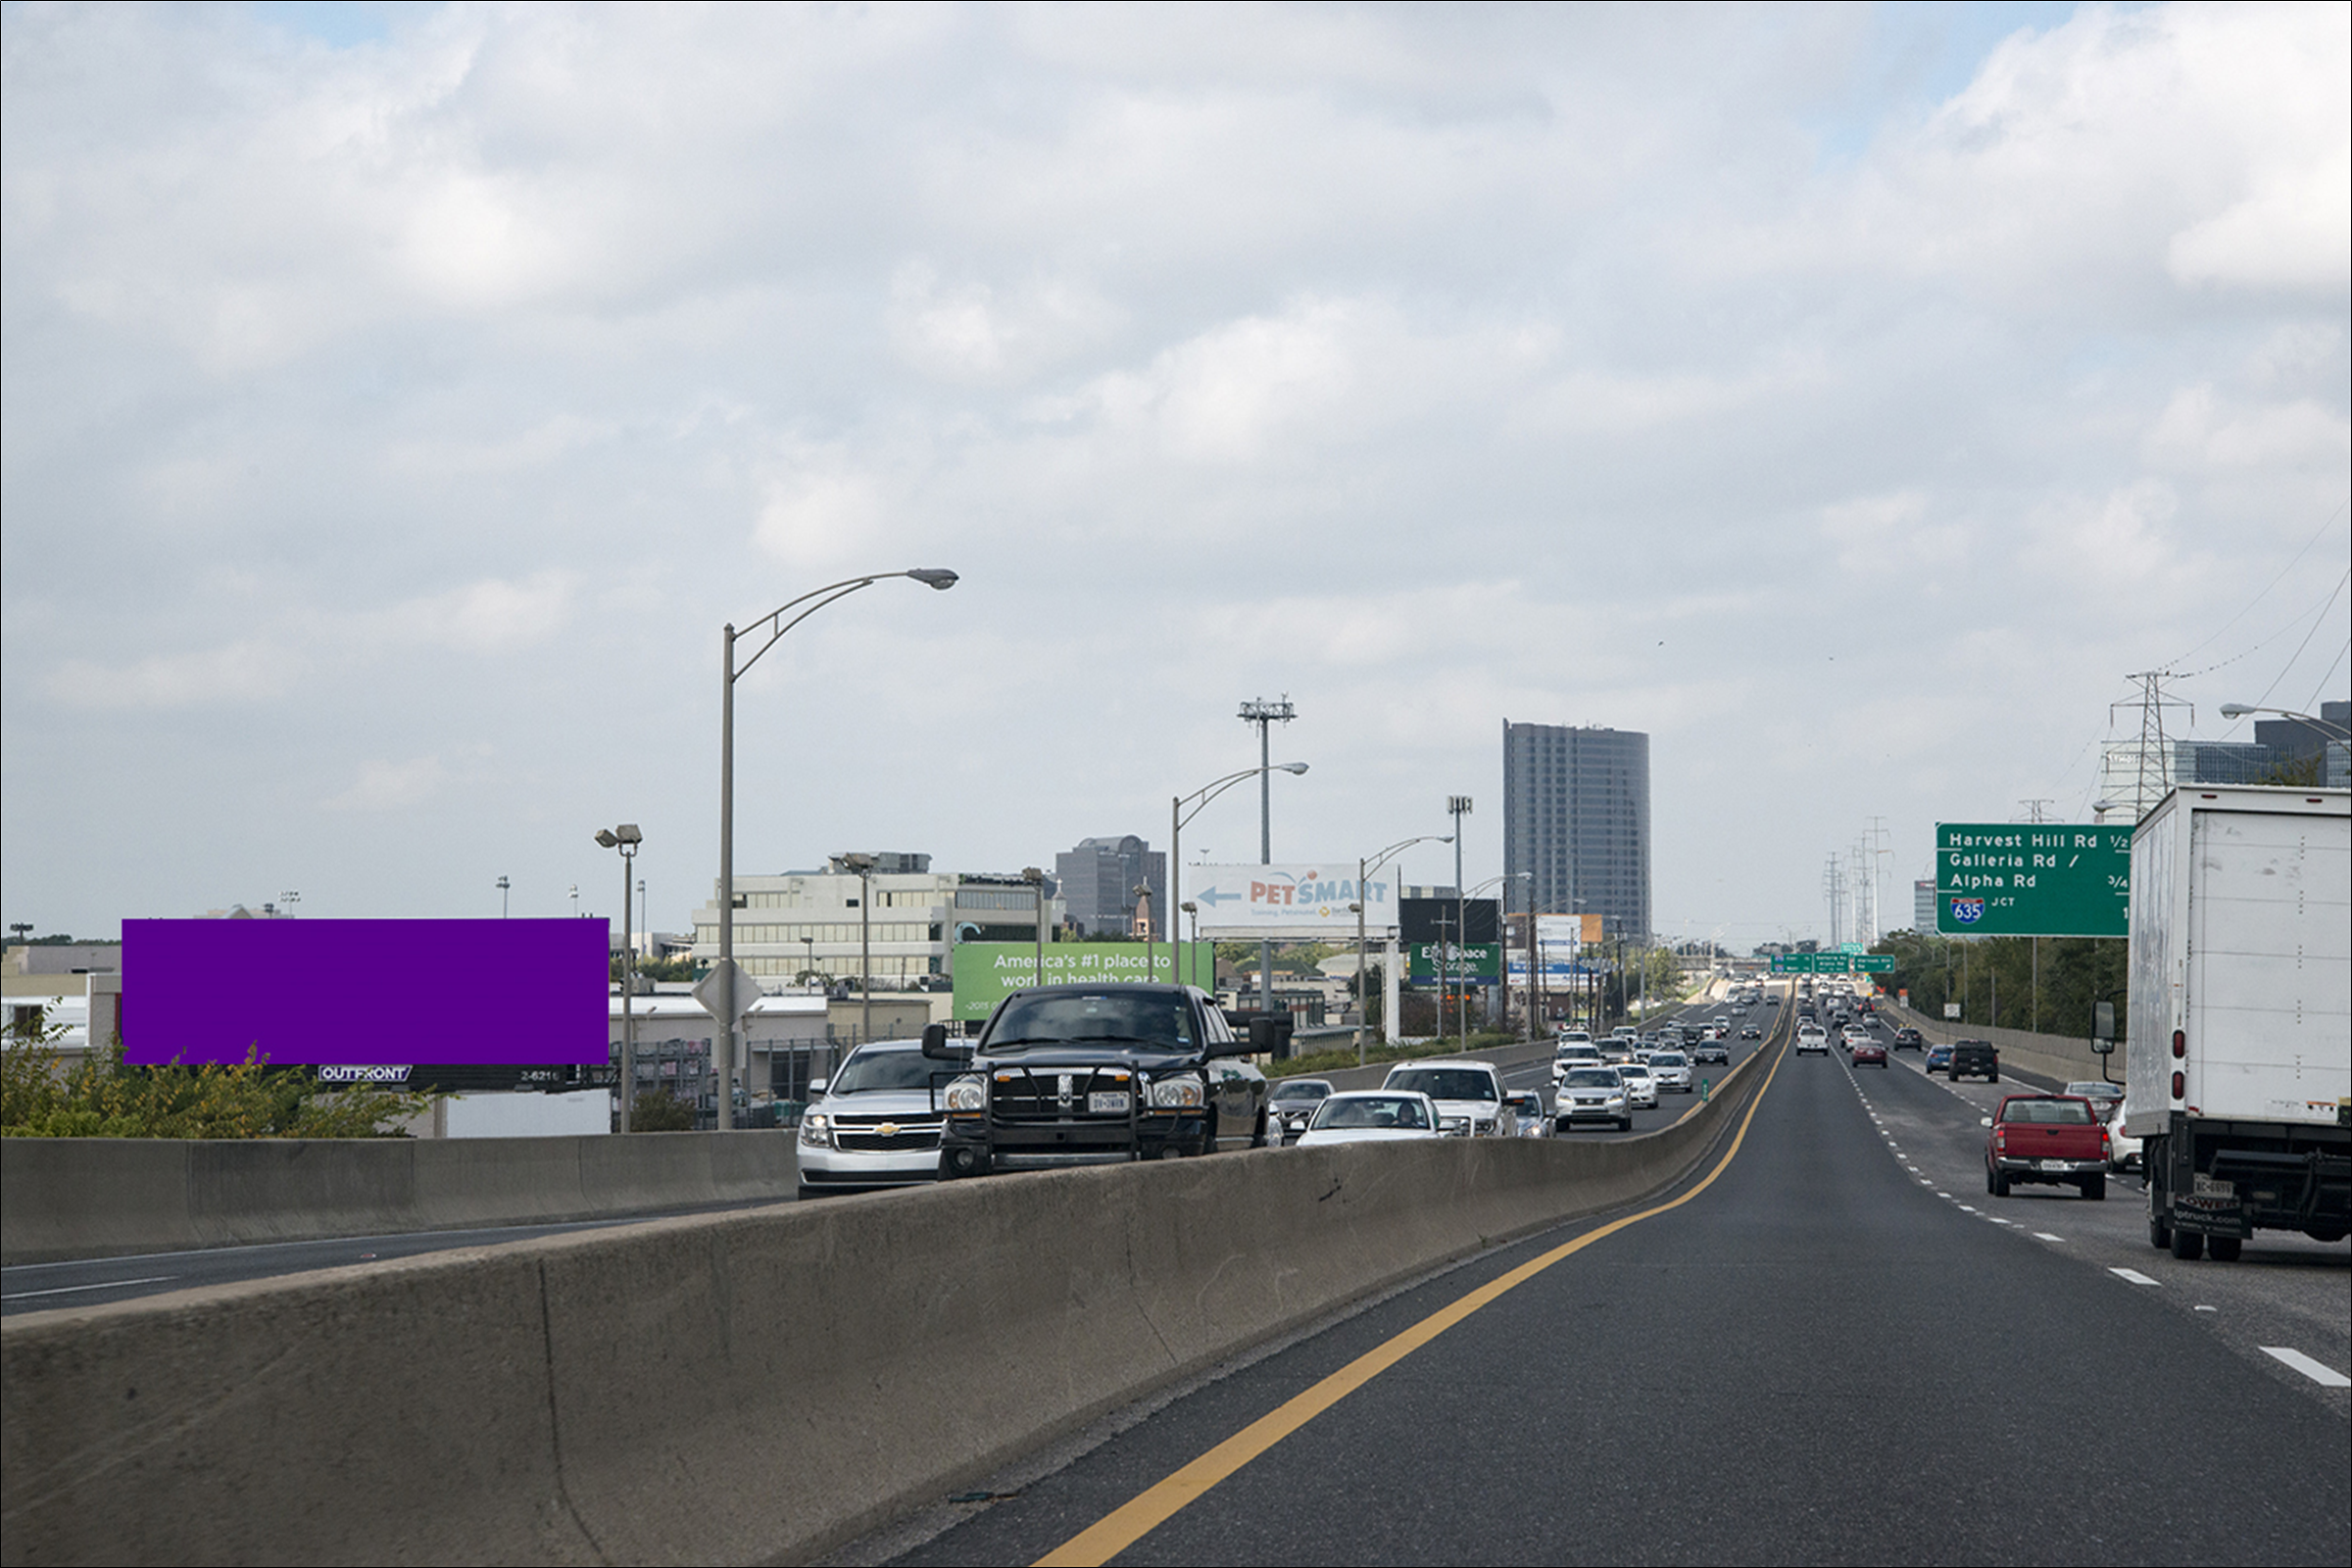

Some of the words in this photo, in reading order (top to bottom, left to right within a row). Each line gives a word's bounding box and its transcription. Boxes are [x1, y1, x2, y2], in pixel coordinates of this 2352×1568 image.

[1949, 833, 2023, 847] Harvest
[2032, 834, 2065, 848] Hill
[2075, 835, 2097, 848] Rd
[1949, 854, 2024, 867] Galleria
[2033, 855, 2056, 867] Rd
[1950, 873, 2004, 890] Alpha
[2013, 874, 2036, 887] Rd
[1954, 904, 1982, 919] 635
[1991, 897, 2016, 906] JCT
[994, 954, 1076, 968] America's
[1081, 954, 1099, 968] #1
[1104, 954, 1149, 970] place
[1153, 955, 1171, 968] to
[1048, 972, 1062, 985] in
[1067, 971, 1118, 984] health
[322, 1066, 406, 1079] OUTFRONT
